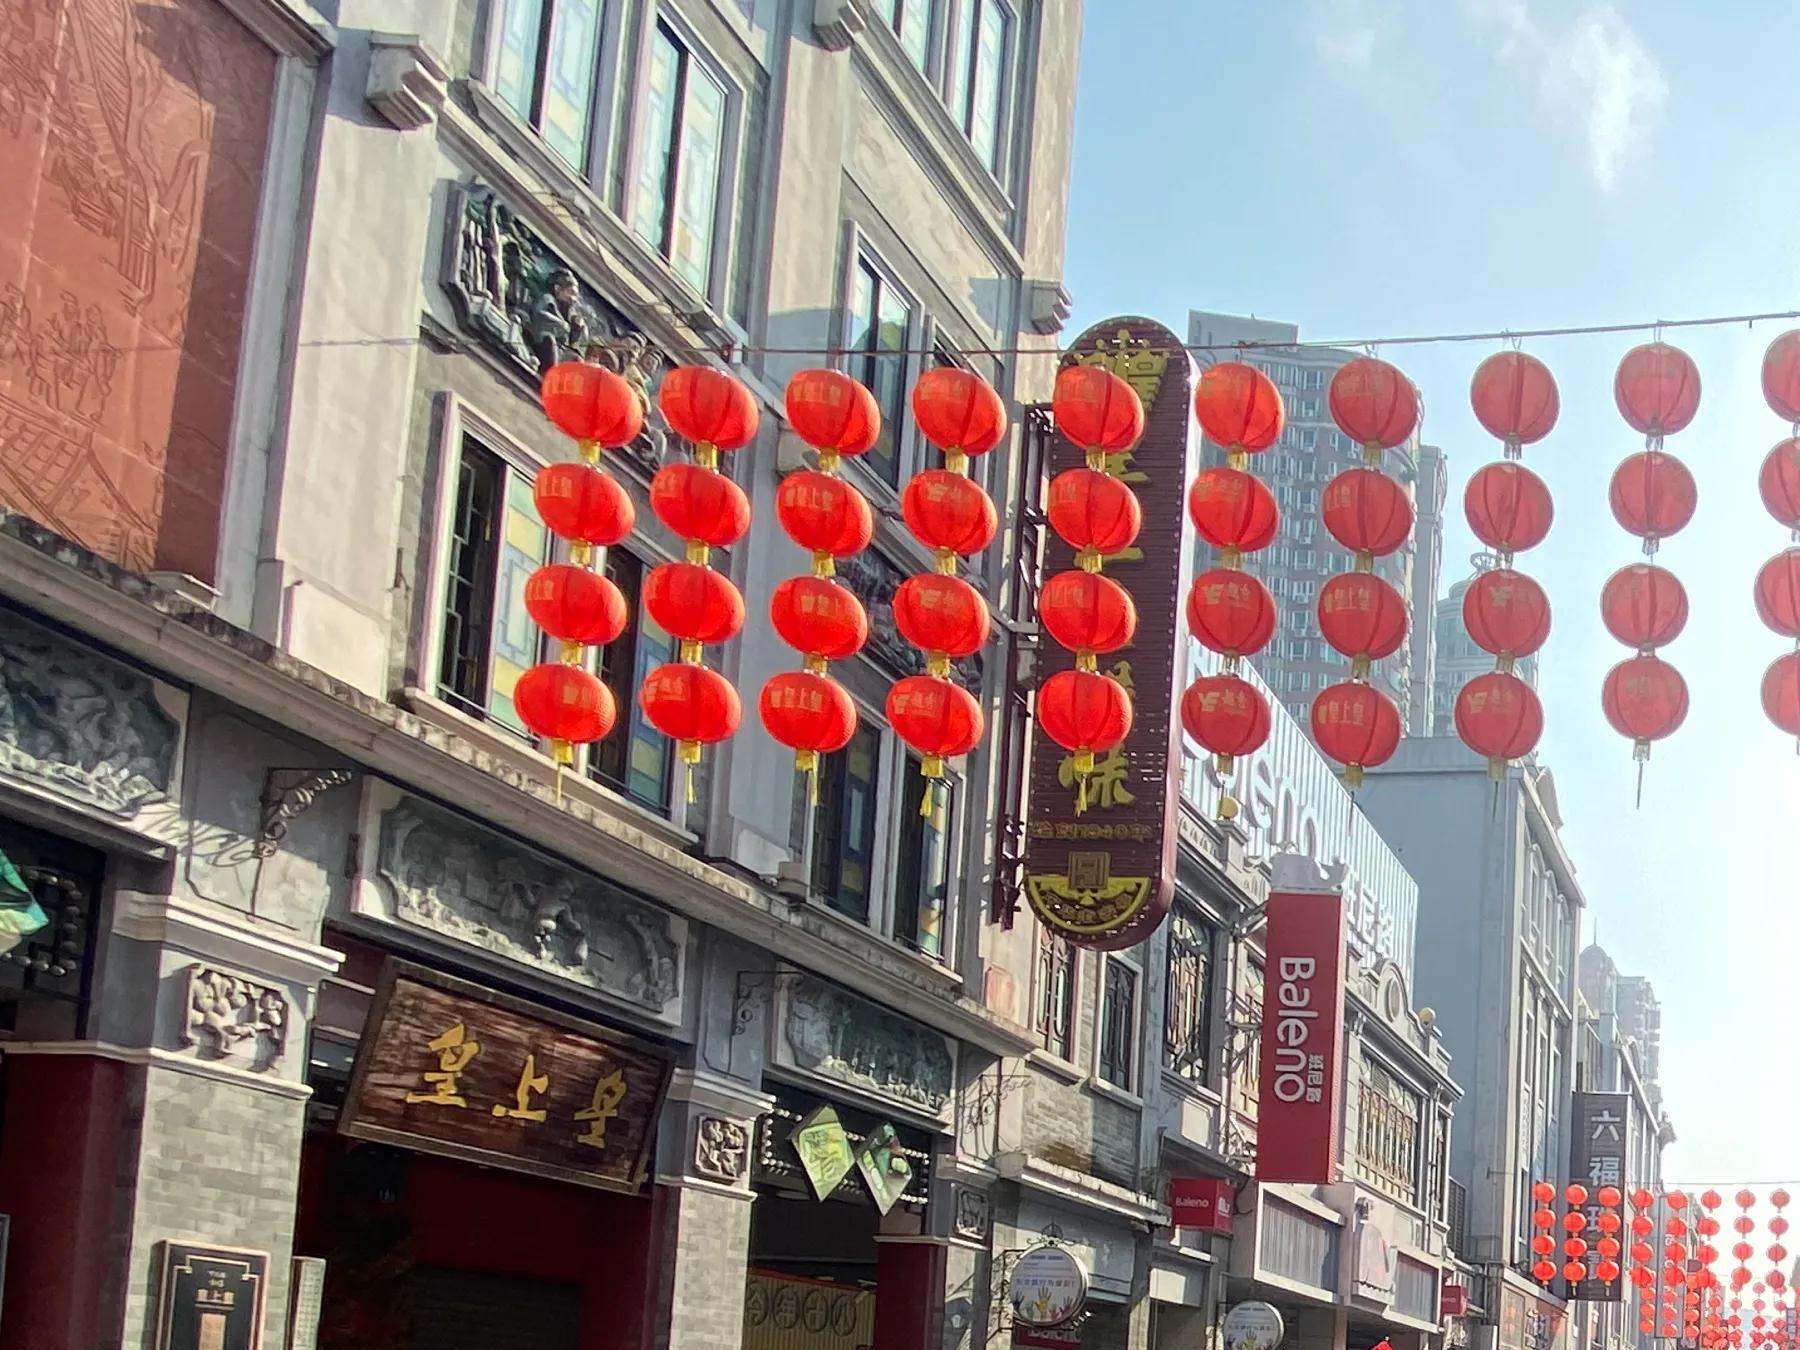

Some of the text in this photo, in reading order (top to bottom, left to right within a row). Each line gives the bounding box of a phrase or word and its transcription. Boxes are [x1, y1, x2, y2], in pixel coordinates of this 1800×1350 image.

[1273, 956, 1319, 1104] Baleno
[1305, 1053, 1325, 1105] 班尼路
[1175, 1196, 1210, 1210] Baleno
